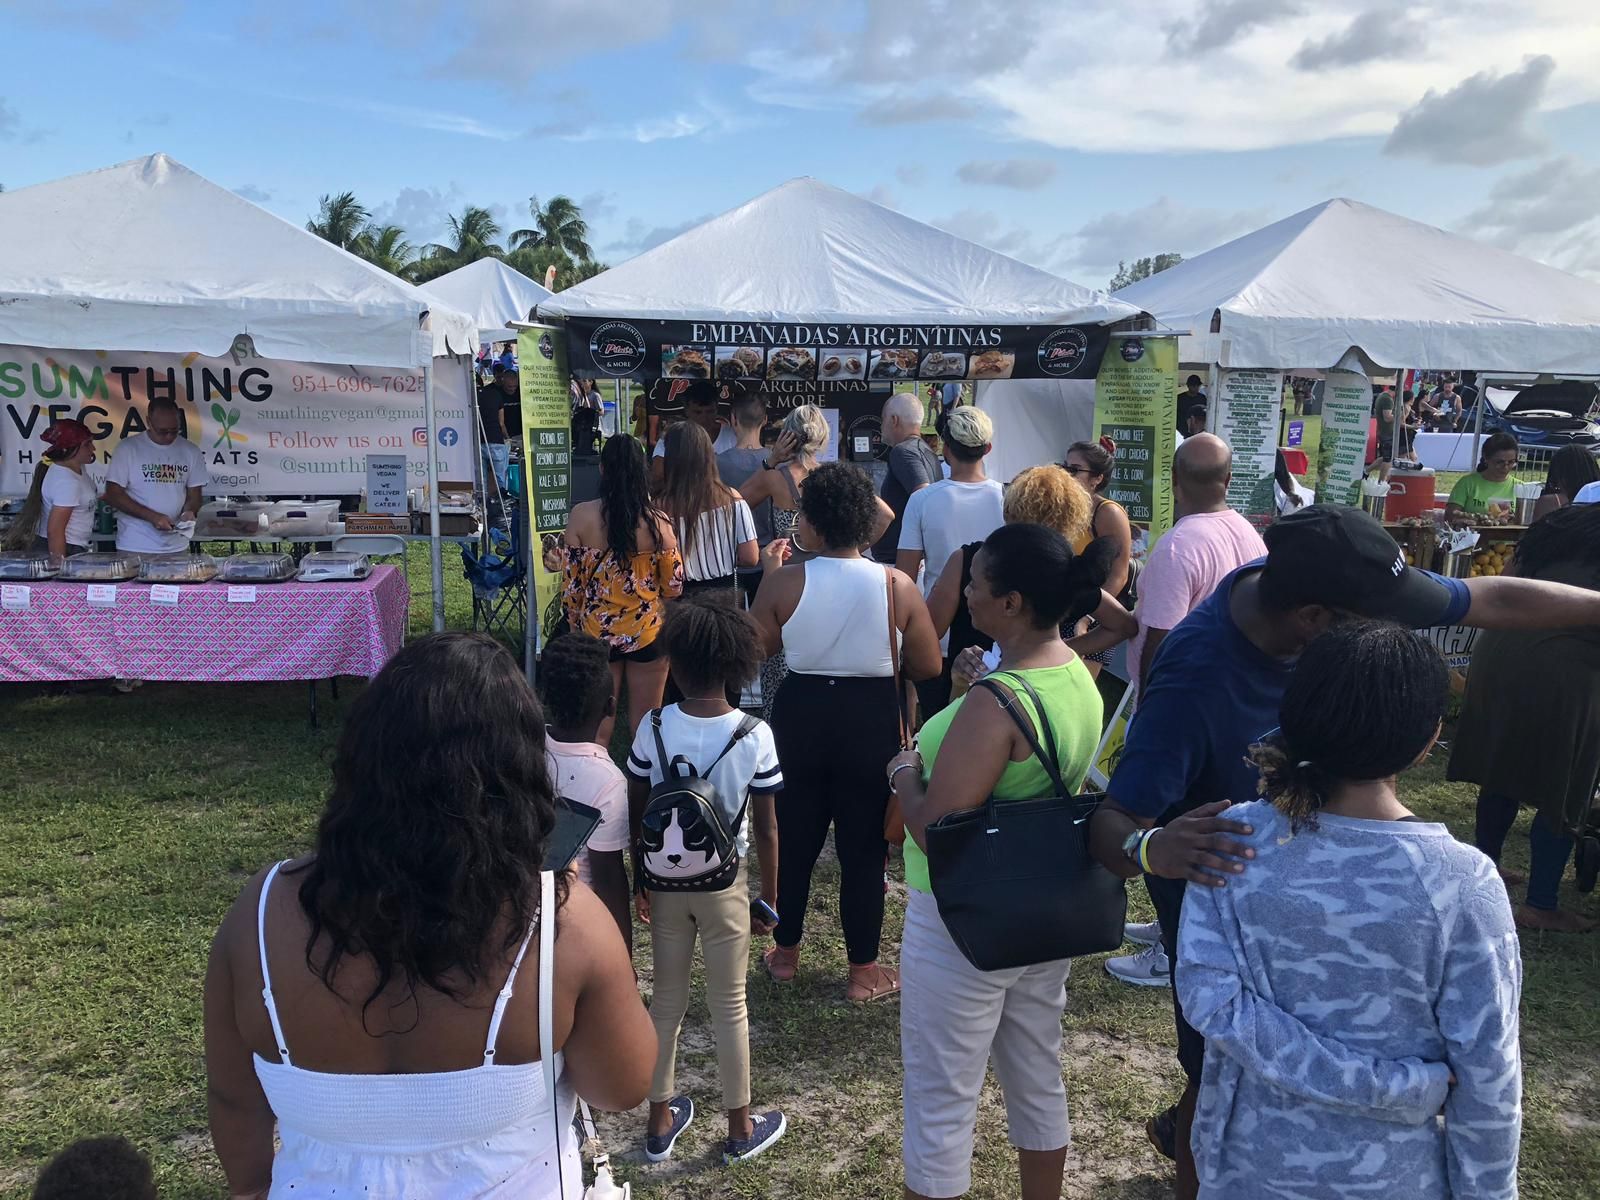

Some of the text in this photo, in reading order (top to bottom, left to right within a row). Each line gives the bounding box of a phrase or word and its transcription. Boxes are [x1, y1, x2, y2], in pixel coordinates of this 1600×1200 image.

[691, 323, 1001, 346] EMPANADAS ARGENTINAS
[0, 362, 273, 401] SUMTHING
[292, 375, 425, 393] 954-696-7625
[760, 380, 868, 392] ARGENTINAS
[777, 395, 826, 408] MORE
[257, 406, 465, 422] sumthingvegan@gmaicom
[1161, 377, 1174, 449] EMPANADAS
[267, 431, 403, 448] Follow us on
[540, 432, 555, 444] BEYOND
[1112, 429, 1144, 441] BEYOND BEEF
[536, 453, 554, 465] BEYOND
[1128, 448, 1149, 460] CHICKEN
[142, 464, 188, 472] SUMTHING
[280, 456, 448, 477] @sumthiegn
[143, 471, 175, 479] VEGAN
[212, 473, 259, 487] vegan!
[1111, 468, 1144, 480] ALE & CORN
[539, 475, 551, 487] KALE
[553, 475, 558, 487] &
[1109, 489, 1140, 502] MUSHROOMS
[1160, 454, 1171, 529] ARGENTINAS
[1133, 506, 1149, 518] SEEDS
[543, 514, 561, 527] SESAME
